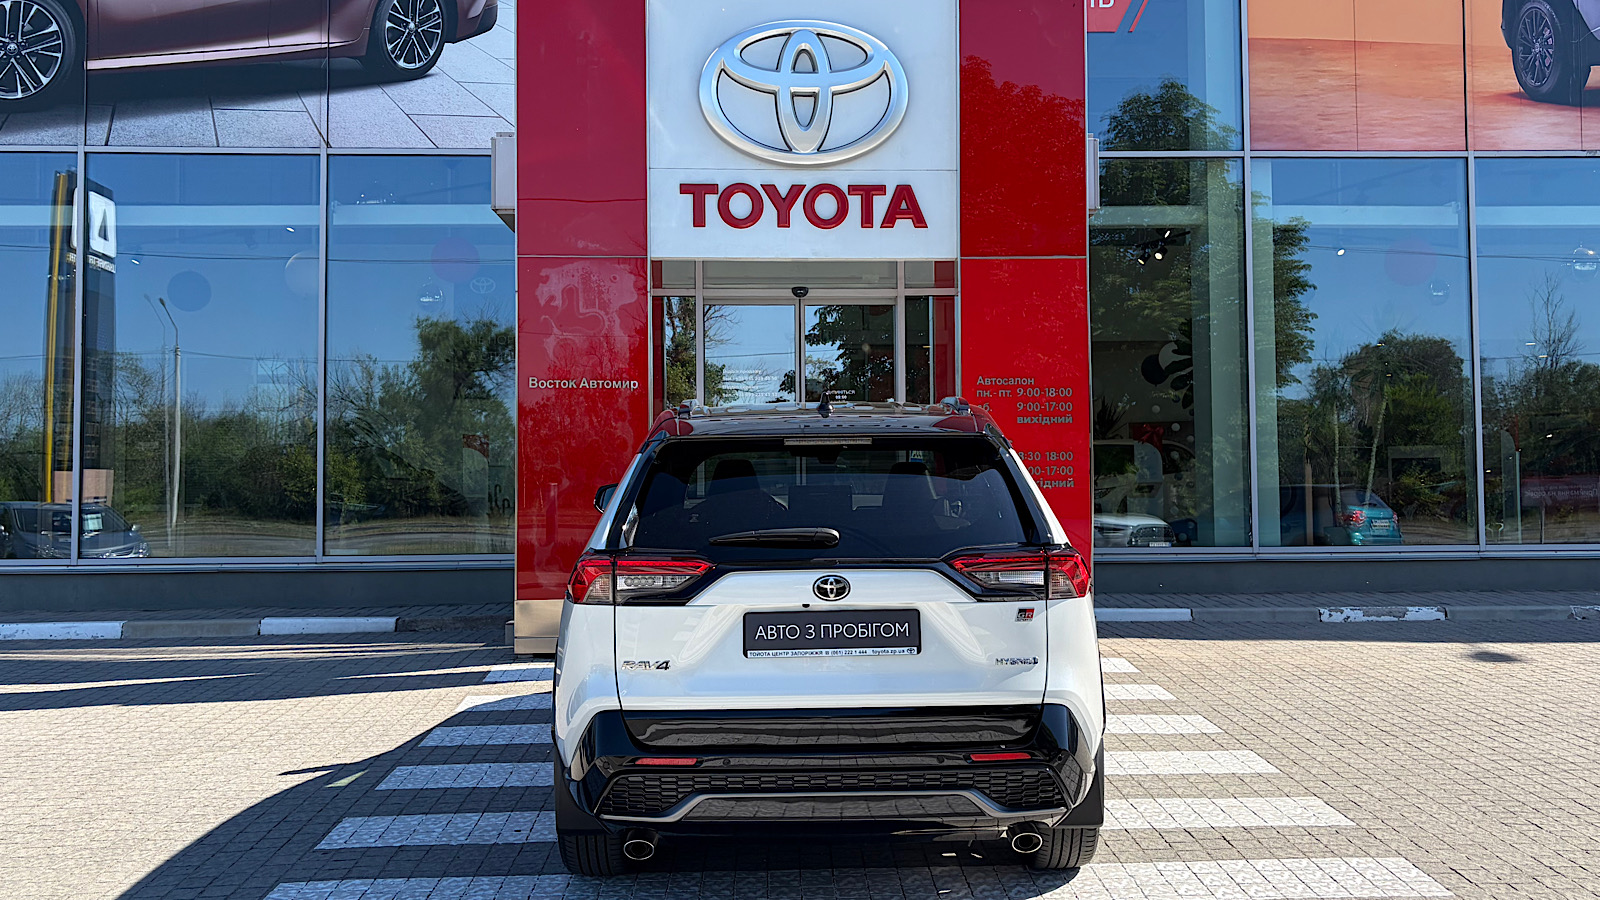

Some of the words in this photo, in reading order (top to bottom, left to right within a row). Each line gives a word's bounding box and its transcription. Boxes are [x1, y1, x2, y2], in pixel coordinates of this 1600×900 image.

[679, 183, 929, 229] TOYOTA
[528, 377, 577, 389] Восток
[580, 377, 639, 391] Автомир
[976, 376, 1034, 385] Автосалон
[1017, 414, 1073, 425] вихідний
[1045, 452, 1074, 461] 18:00
[755, 624, 800, 640] АВТО
[820, 622, 909, 639] ПРОБІГОМ
[621, 660, 671, 670] RAV4
[995, 657, 1039, 665] HYBRID
